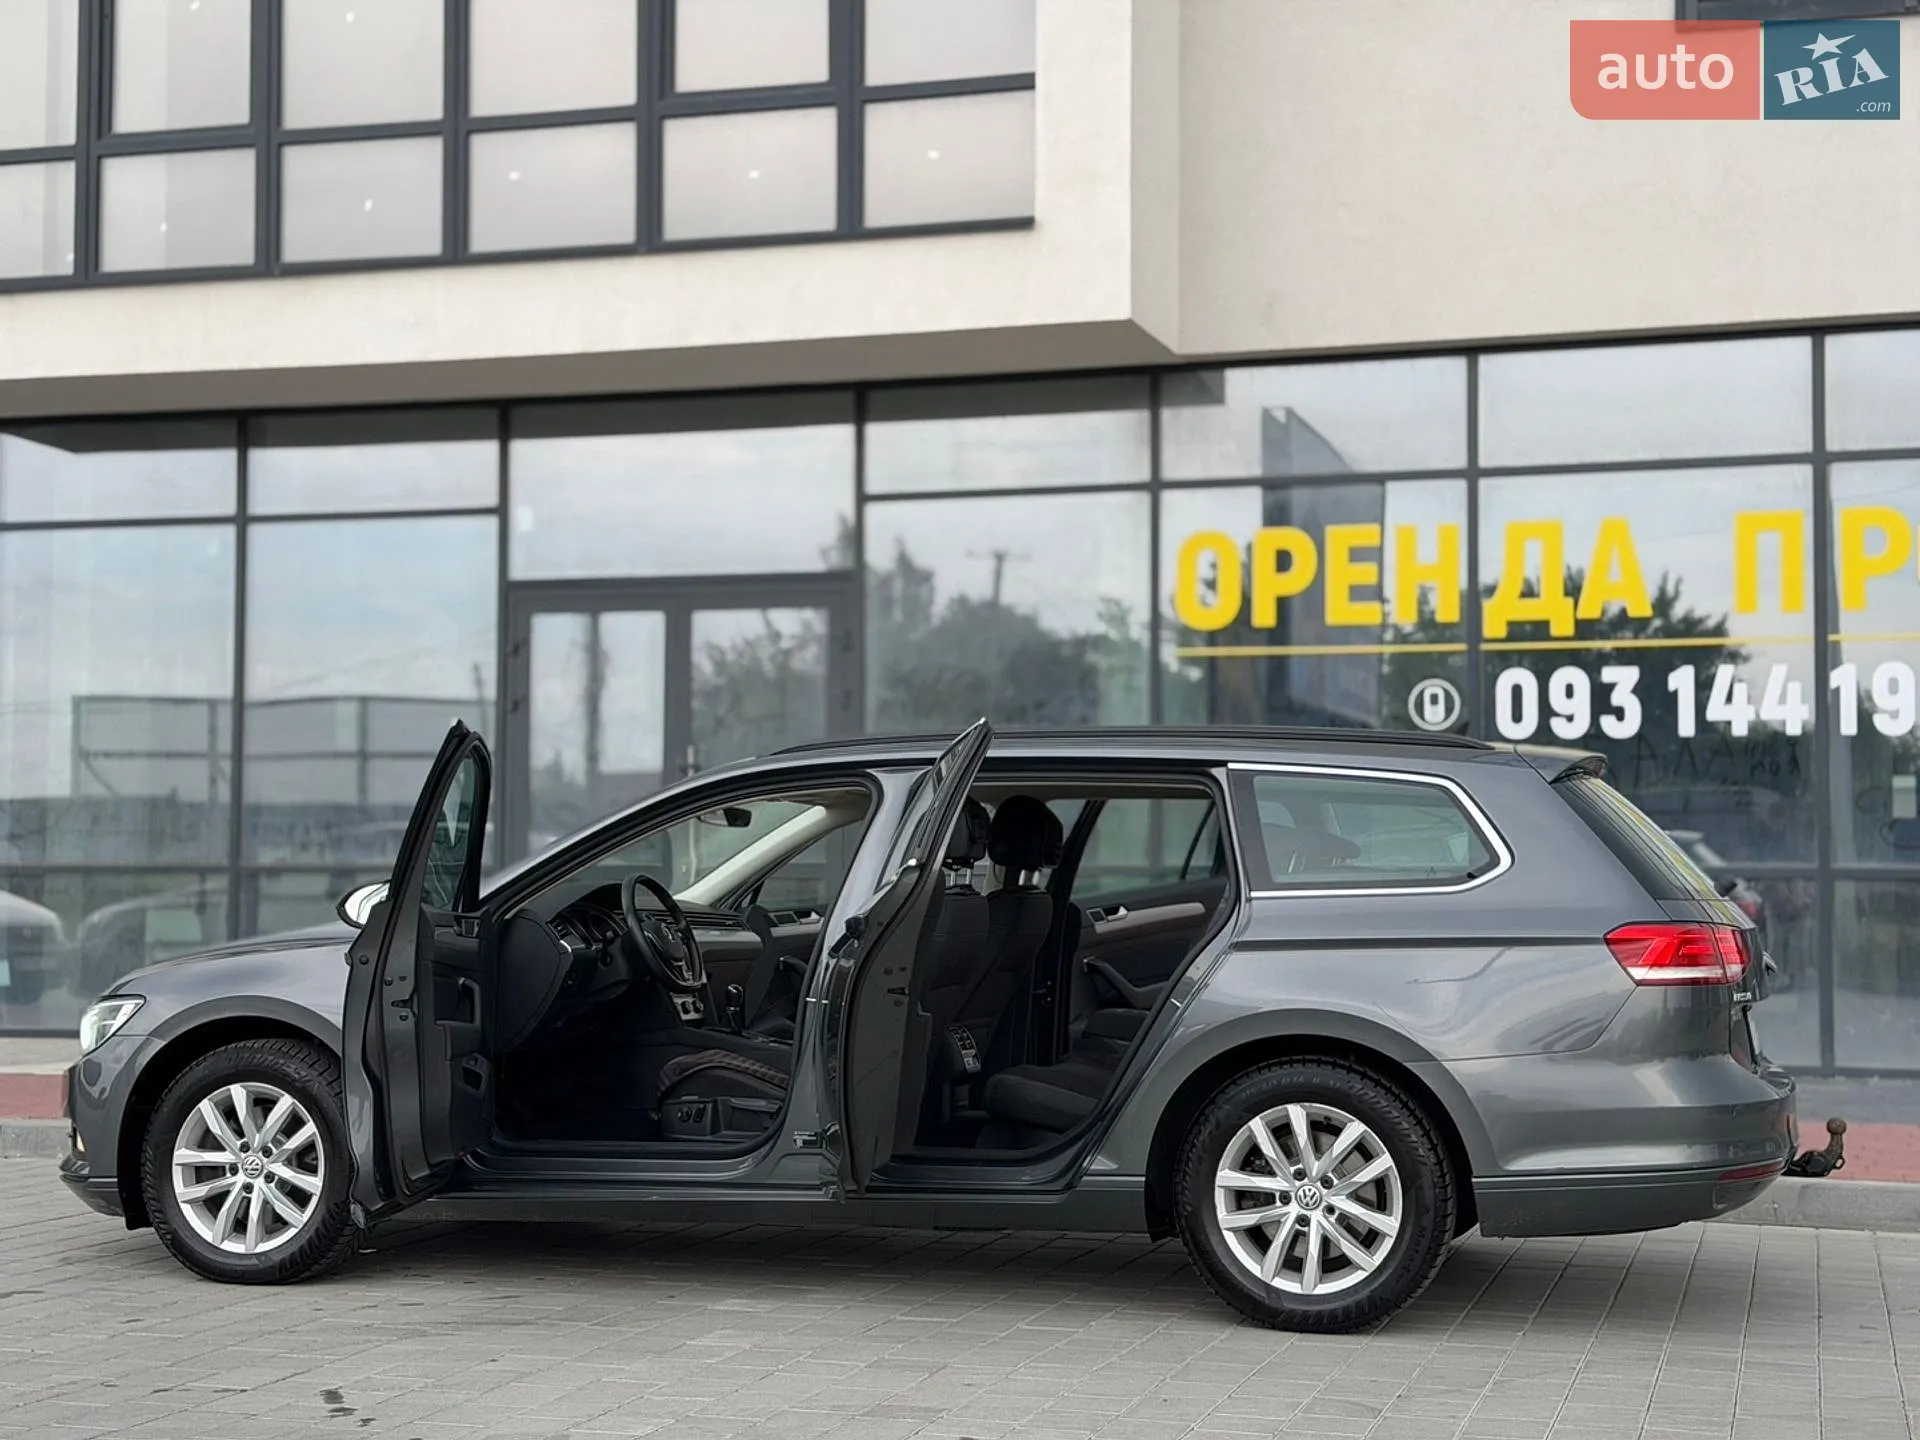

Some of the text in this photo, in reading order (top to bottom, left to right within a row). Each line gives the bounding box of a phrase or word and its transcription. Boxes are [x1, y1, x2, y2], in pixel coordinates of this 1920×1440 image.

[1175, 506, 1920, 638] ОРЕНДА ПР
[1495, 665, 1642, 740] 093
[1667, 663, 1809, 737] 144
